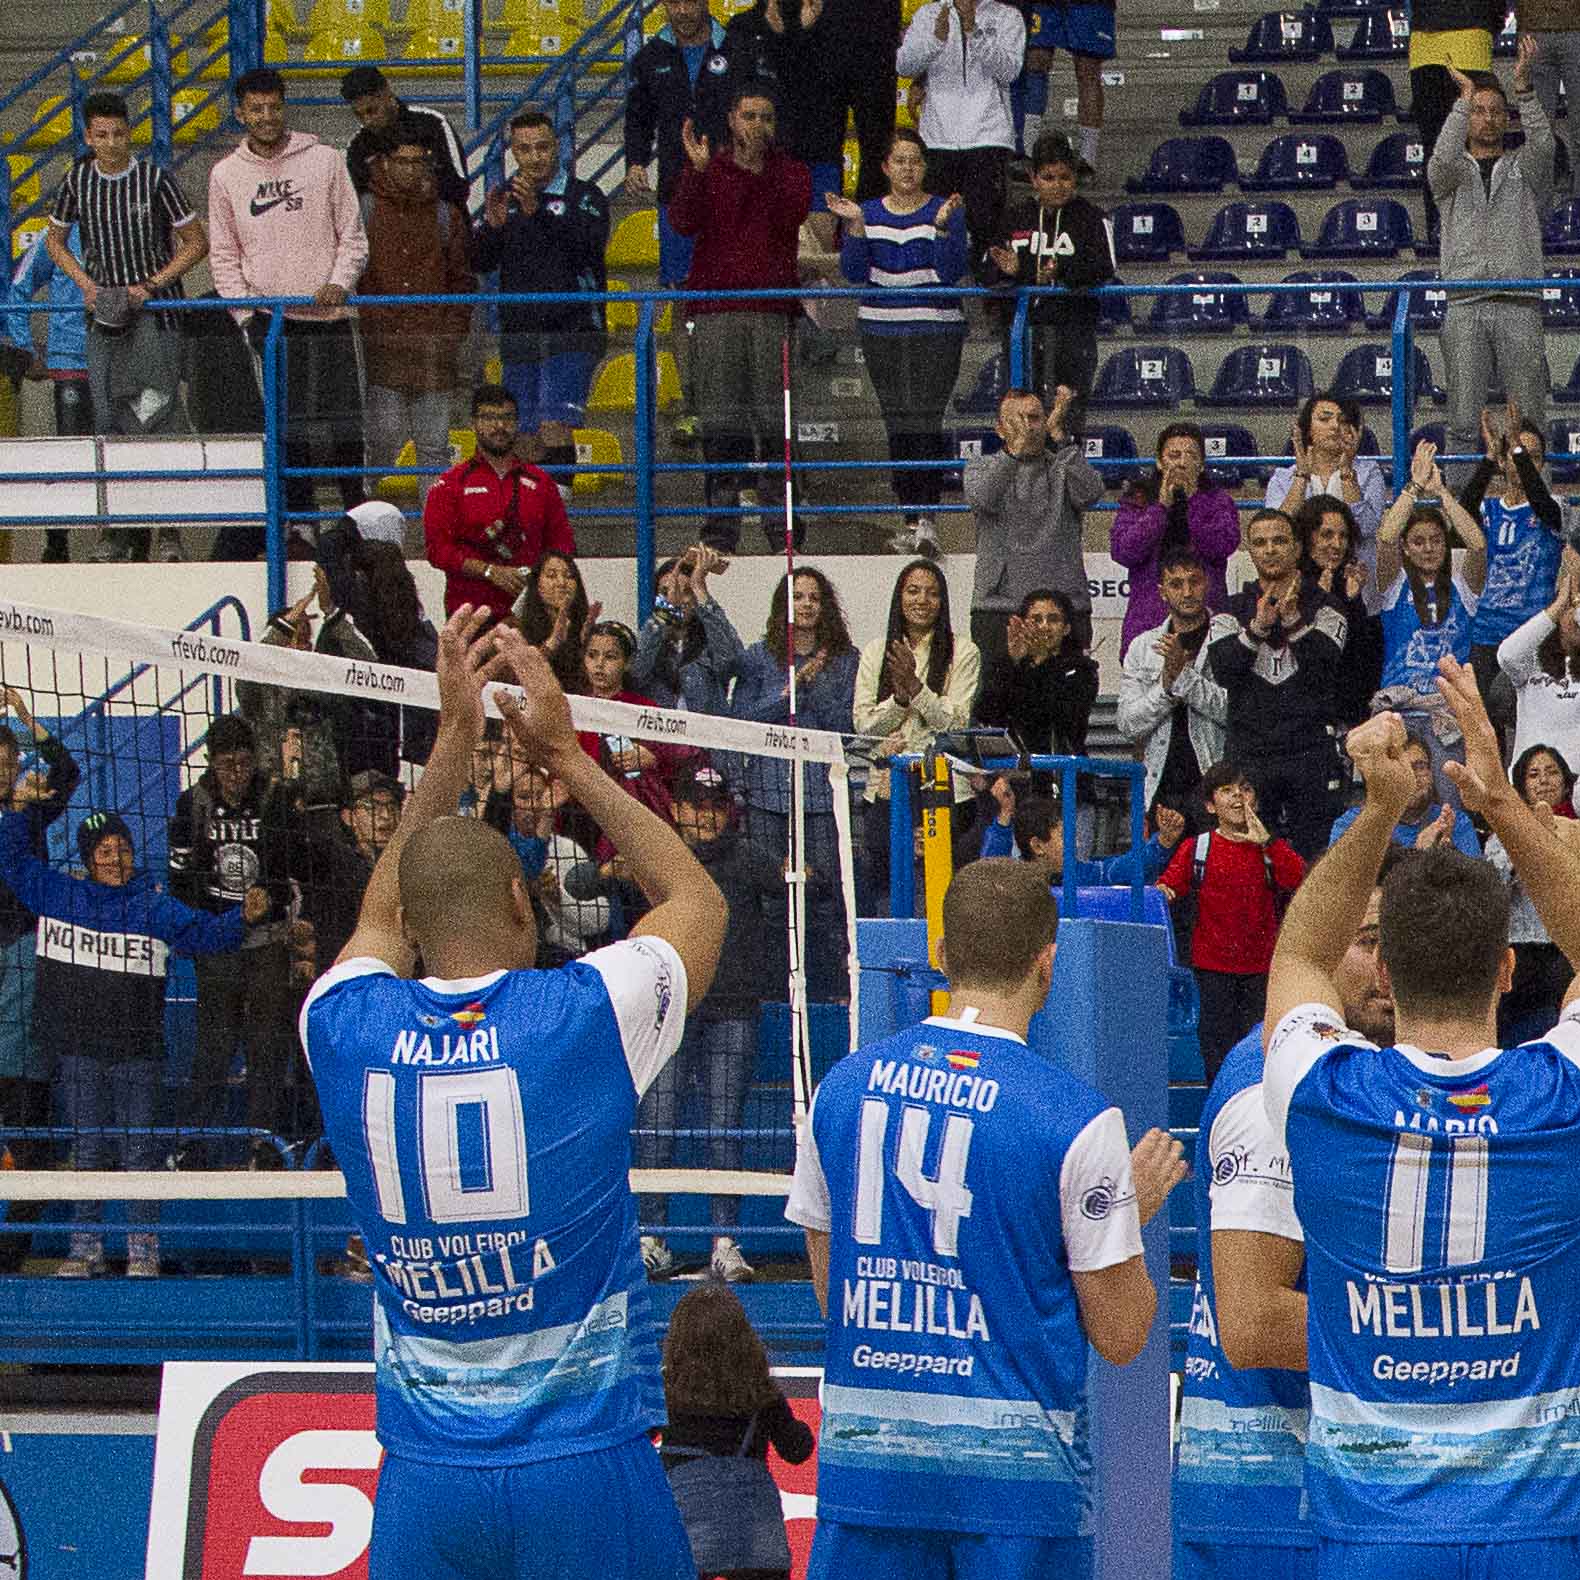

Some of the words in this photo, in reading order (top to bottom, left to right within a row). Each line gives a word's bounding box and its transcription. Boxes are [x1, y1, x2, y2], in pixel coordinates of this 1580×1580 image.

[80, 932, 154, 961] RULES
[391, 1026, 500, 1066] NAJARI
[868, 1058, 1000, 1114] MAURICIO
[361, 1062, 531, 1225] 10
[851, 1094, 974, 1258] 14
[1381, 1131, 1490, 1275] 11
[374, 1237, 557, 1301] MELILLA
[390, 1234, 434, 1260] CLUB
[857, 1255, 898, 1280] CLUB
[842, 1278, 991, 1343] MELILLA
[1346, 1275, 1541, 1339] MELILLA
[852, 1344, 975, 1378] Geeppard
[1372, 1351, 1521, 1388] Geeppard
